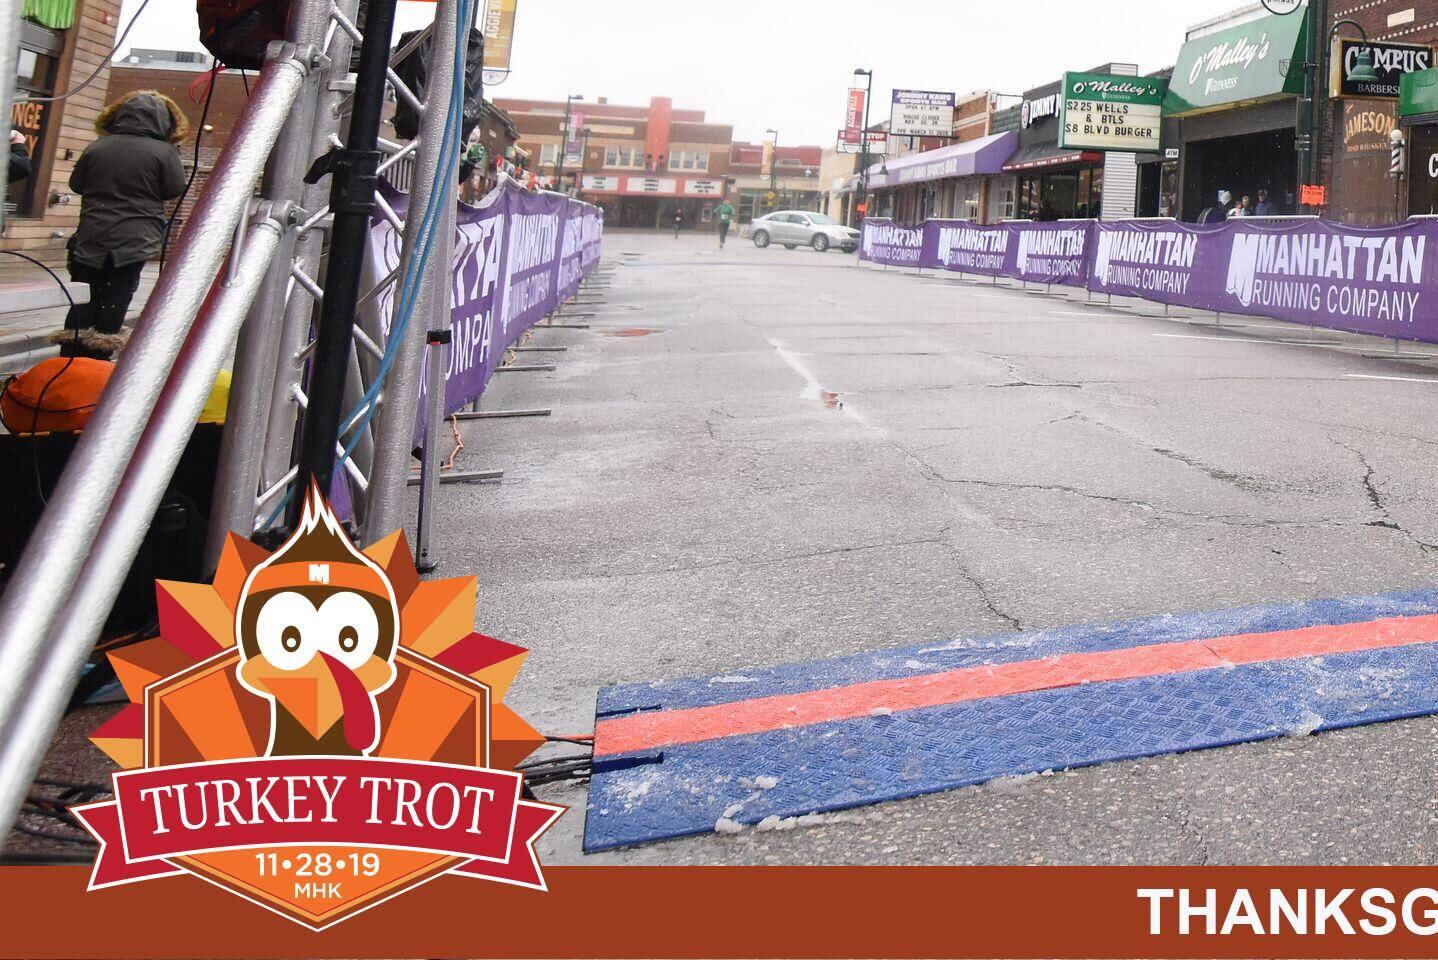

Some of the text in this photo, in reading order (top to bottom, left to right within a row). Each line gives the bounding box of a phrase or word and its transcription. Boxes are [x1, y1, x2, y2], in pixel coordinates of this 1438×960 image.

[1189, 32, 1270, 85] O'Malley's
[1345, 46, 1429, 81] CMPUS
[1073, 81, 1157, 95] O'Malley's
[1084, 125, 1110, 135] BLVD
[1115, 127, 1152, 137] BURGER
[1086, 114, 1124, 124] & BTLS
[1344, 111, 1396, 143] JAMESON
[1166, 149, 1178, 157] ATM
[872, 226, 923, 247] MANHATTAN
[951, 228, 1009, 252] MANHATTAN
[1029, 229, 1086, 257] MANHATTAN
[949, 251, 1005, 270] RUNNING COMPANY
[1111, 232, 1198, 268] MANHATTAN
[1257, 234, 1426, 283] MANHATTAN
[1026, 257, 1081, 278] RUNNING COMPANY
[1107, 264, 1190, 295] RUNNING COMPANY
[1252, 278, 1420, 322] RUNNING COMPANY
